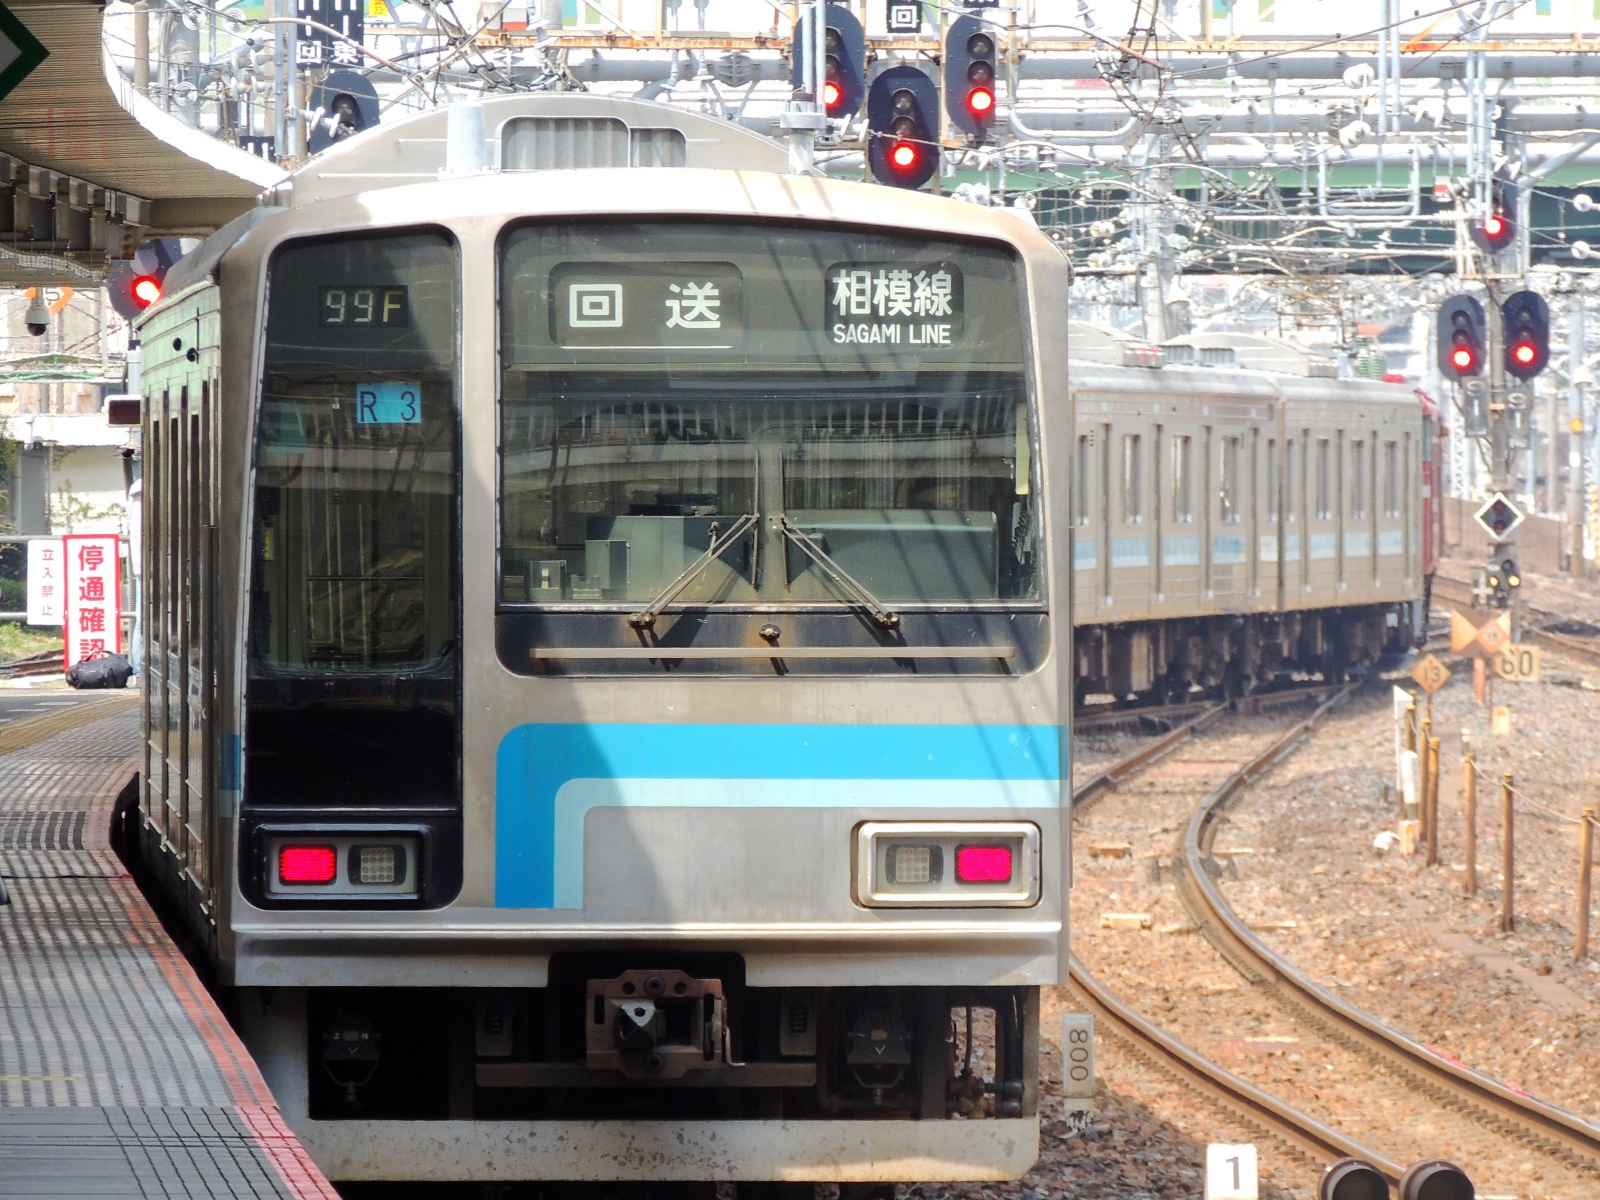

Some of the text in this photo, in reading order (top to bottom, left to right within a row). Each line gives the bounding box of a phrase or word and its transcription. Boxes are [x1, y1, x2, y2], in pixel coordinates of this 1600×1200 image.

[326, 290, 404, 323] 99F
[569, 282, 721, 329] 回送
[832, 269, 952, 316] 相模線
[833, 323, 951, 344] SAGAMI LINE
[359, 391, 416, 422] R 3
[41, 548, 54, 616] 立入禁止
[78, 544, 106, 663] 停通確認
[1069, 1029, 1089, 1081] 800
[1225, 1156, 1240, 1191] 1
